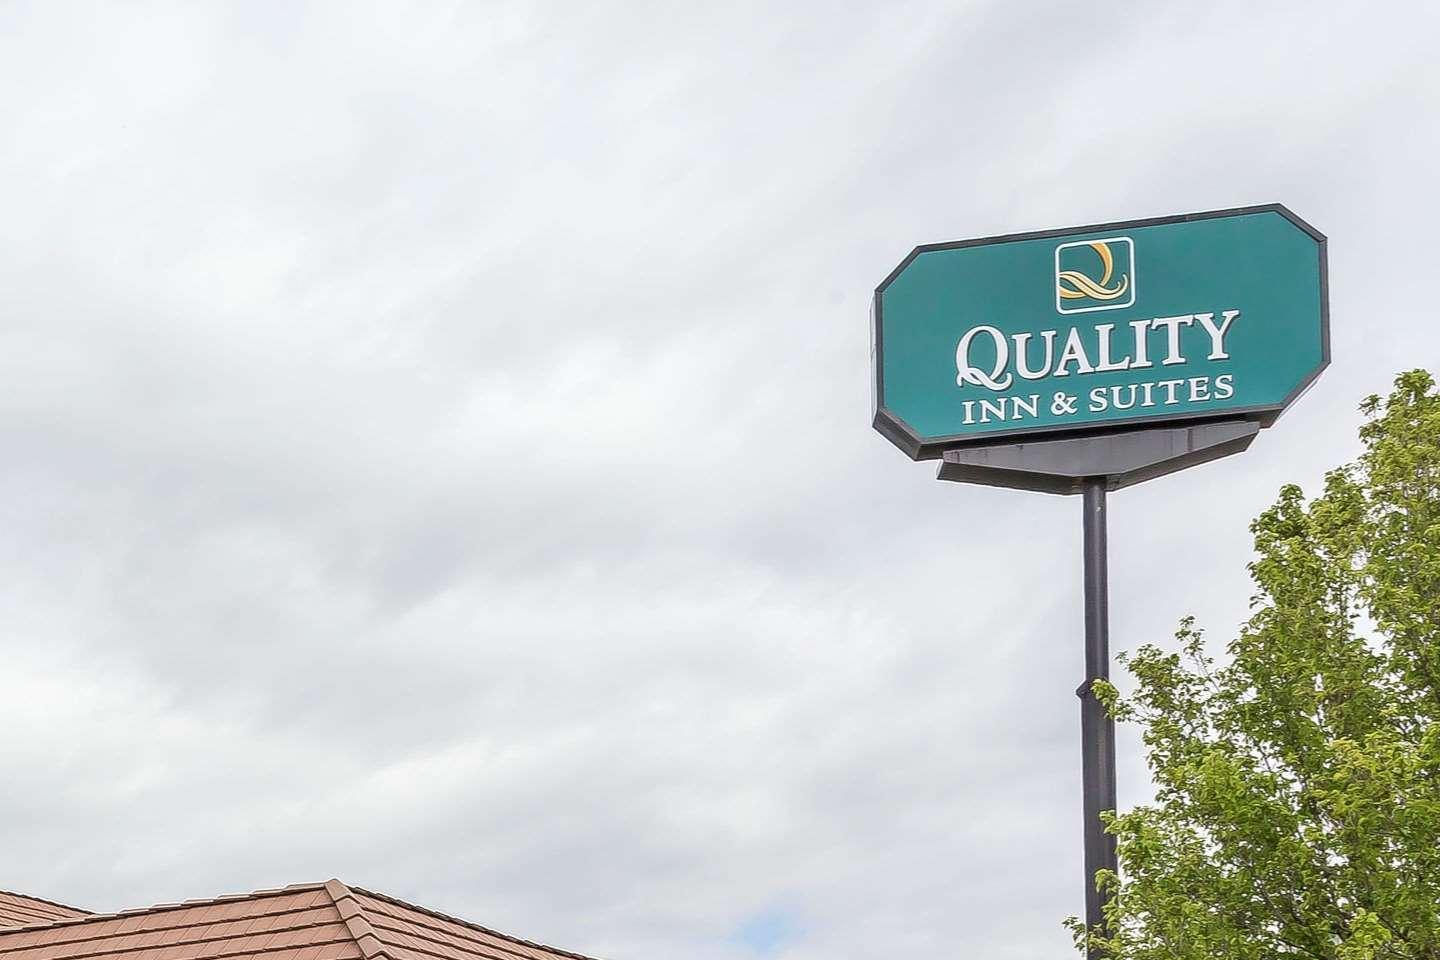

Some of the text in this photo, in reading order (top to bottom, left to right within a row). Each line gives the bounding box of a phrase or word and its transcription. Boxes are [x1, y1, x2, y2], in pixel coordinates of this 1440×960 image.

[955, 309, 1240, 391] QUALITY
[961, 374, 1235, 425] INN & SUITES
